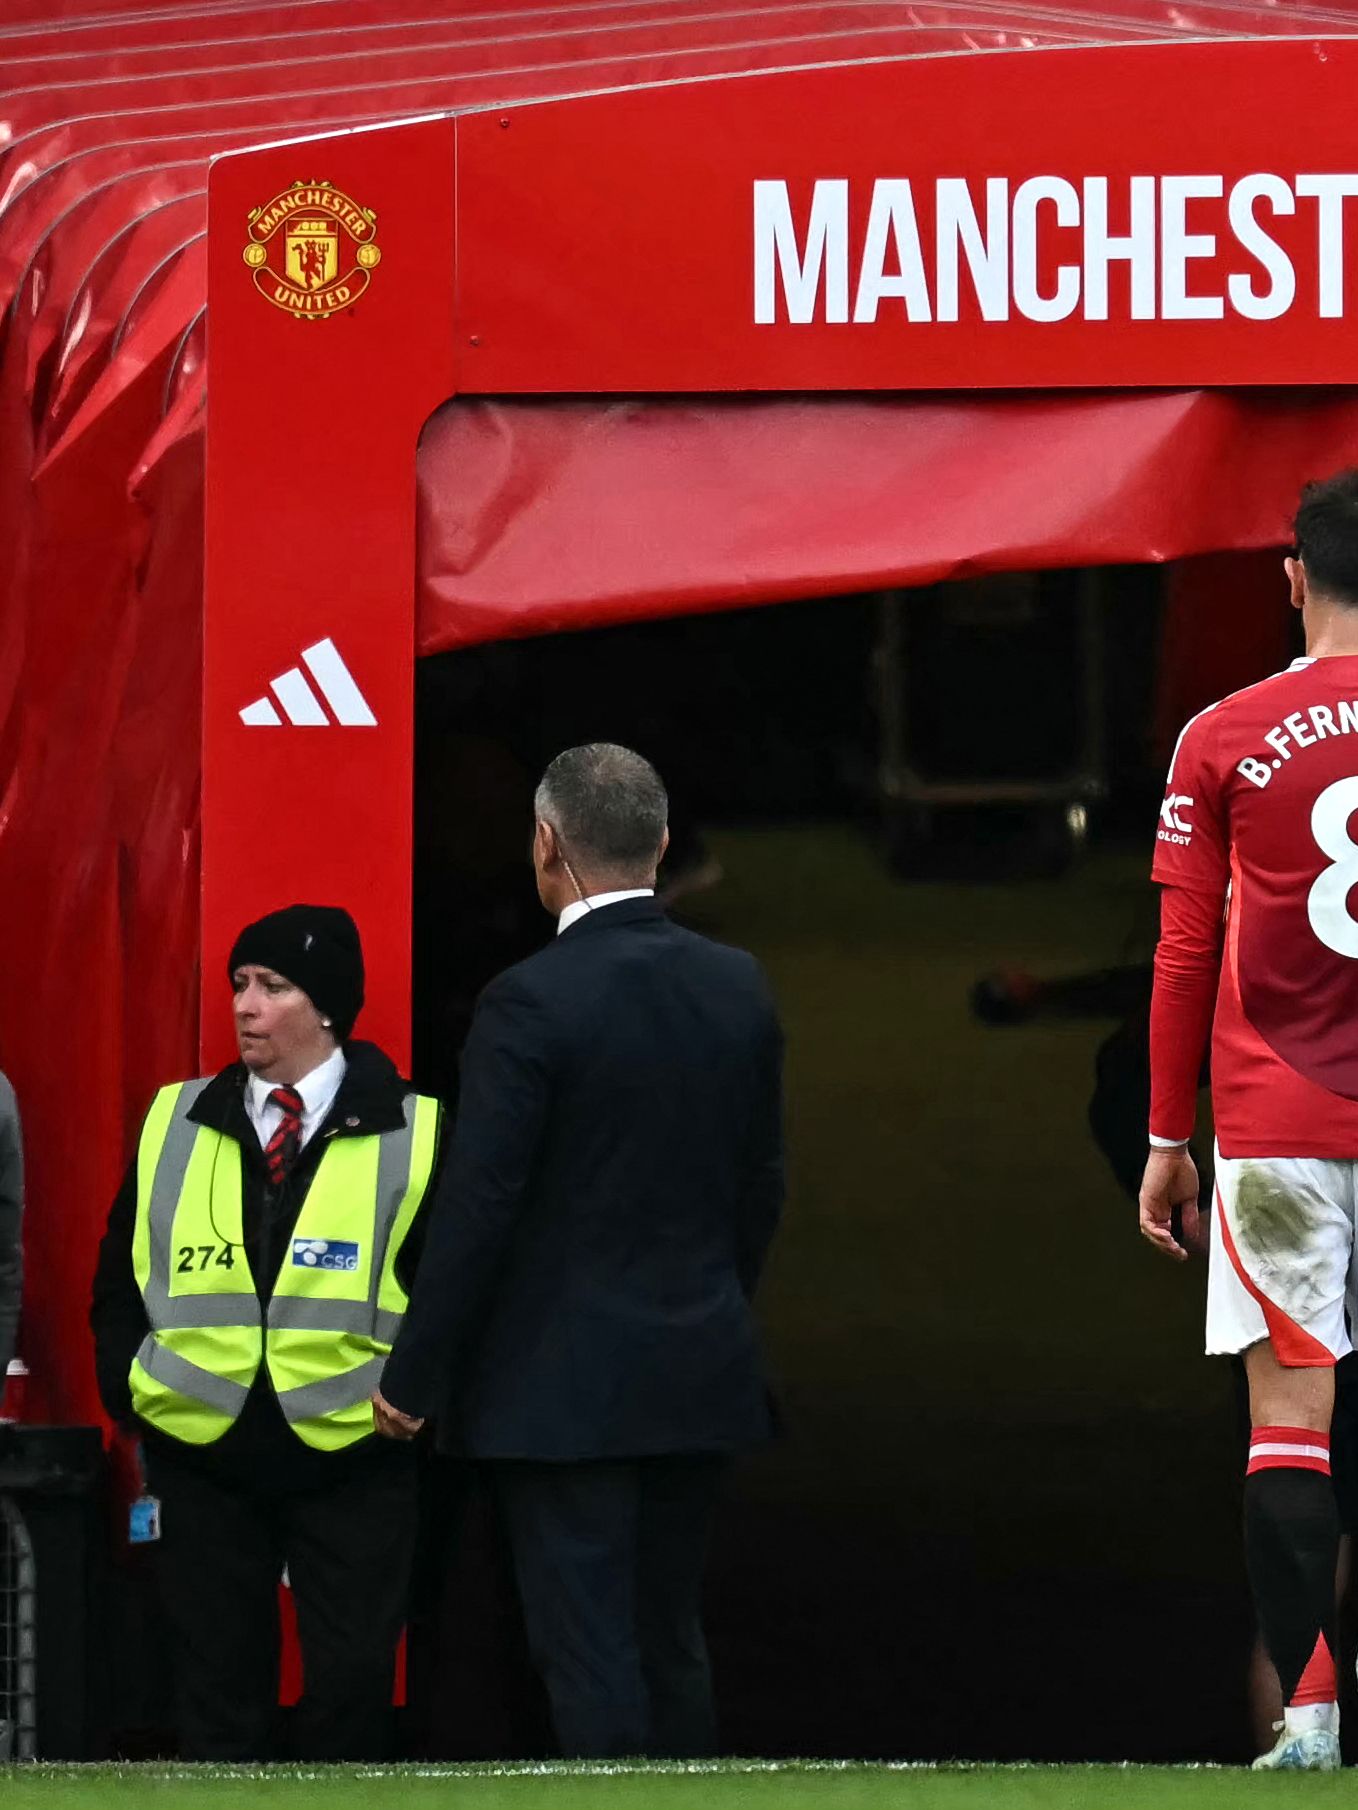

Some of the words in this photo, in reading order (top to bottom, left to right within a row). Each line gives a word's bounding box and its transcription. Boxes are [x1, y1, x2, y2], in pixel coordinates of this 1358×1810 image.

[257, 190, 367, 235] MANCHESTER
[274, 286, 350, 310] UNITED
[177, 1244, 235, 1274] 274
[321, 1253, 358, 1270] CSG
